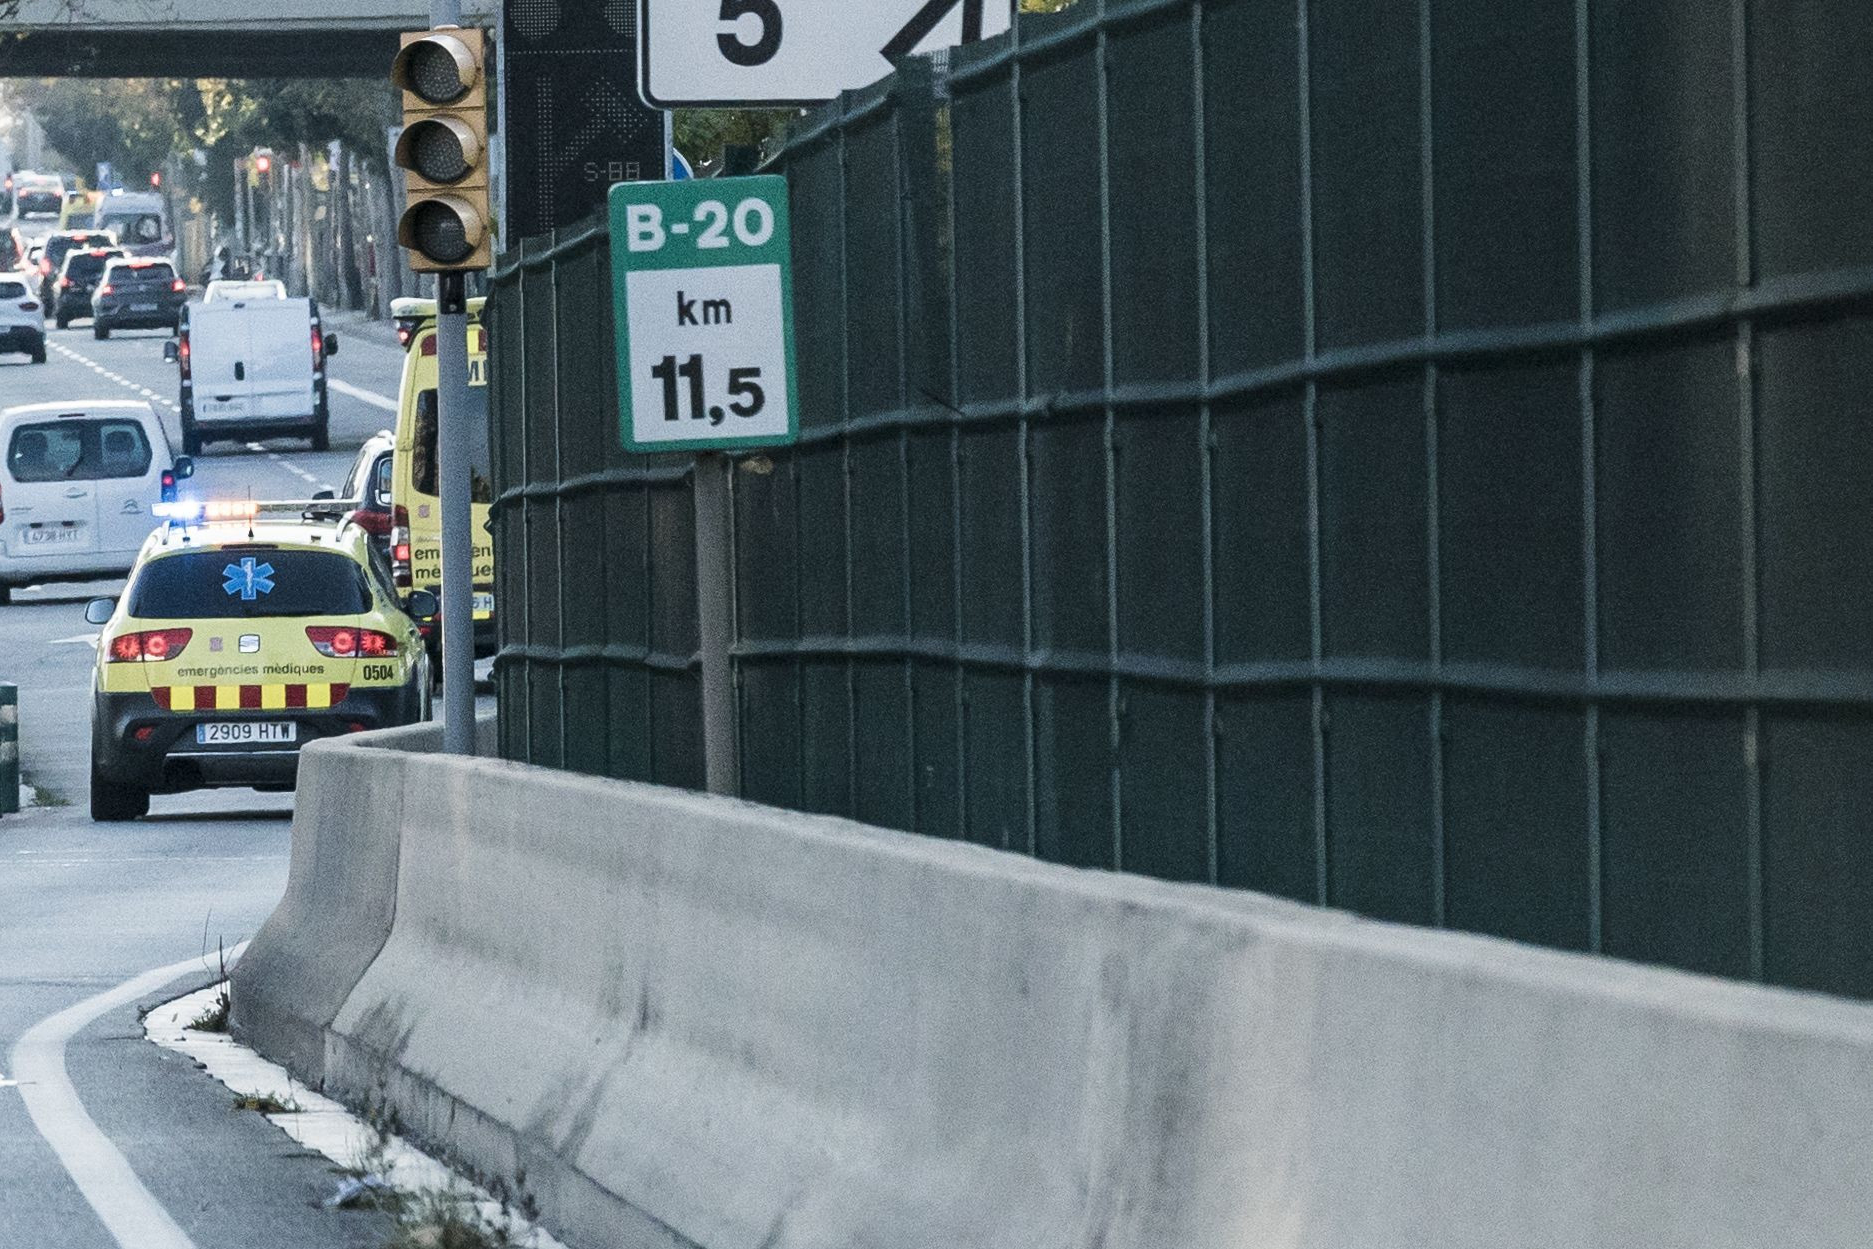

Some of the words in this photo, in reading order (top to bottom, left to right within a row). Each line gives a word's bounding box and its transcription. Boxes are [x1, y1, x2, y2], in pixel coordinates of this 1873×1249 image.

[627, 198, 776, 252] B-20
[677, 291, 733, 327] km
[652, 354, 767, 427] 11,5
[363, 665, 395, 681] 0504
[209, 725, 252, 740] 2909
[258, 724, 290, 739] HTW
